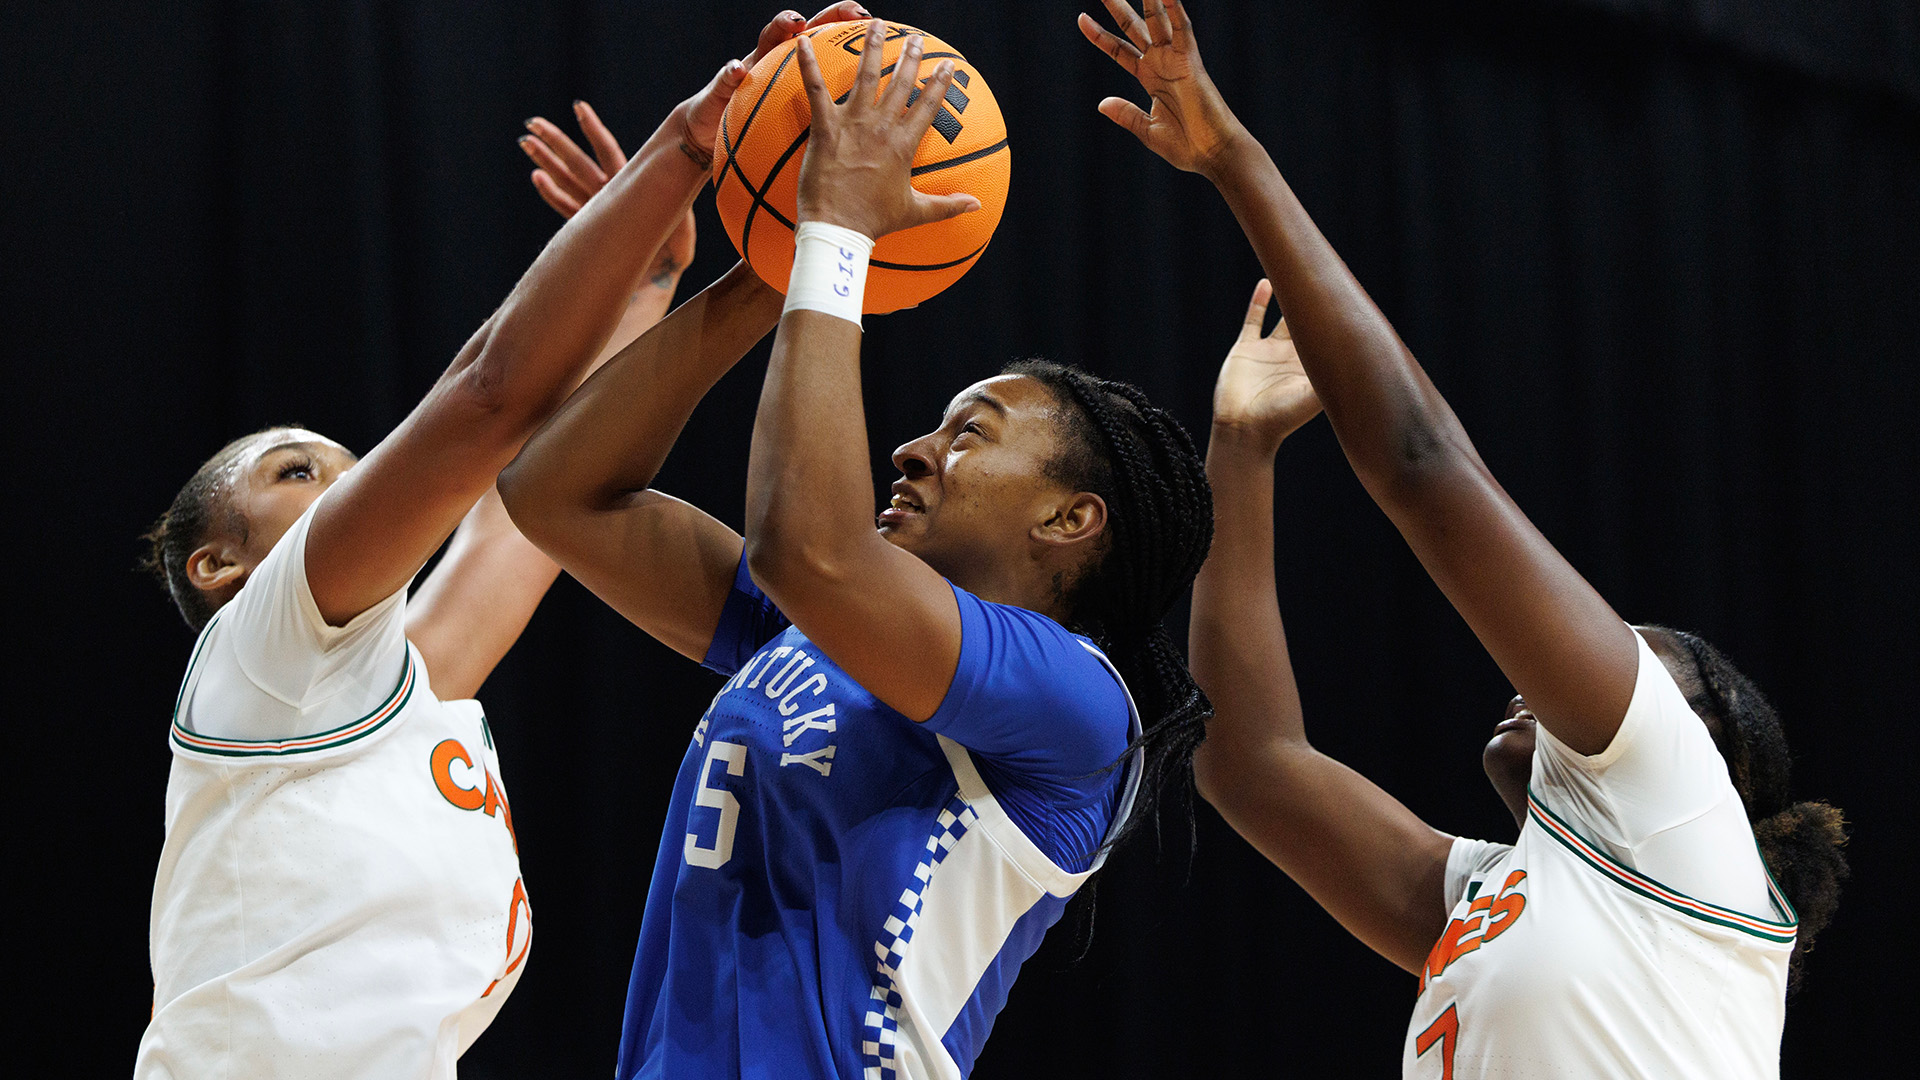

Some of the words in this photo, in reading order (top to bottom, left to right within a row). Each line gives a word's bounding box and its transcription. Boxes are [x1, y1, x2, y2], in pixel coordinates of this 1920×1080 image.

[694, 646, 837, 777] NTUCKY
[430, 738, 519, 856] CA
[684, 740, 748, 870] 5
